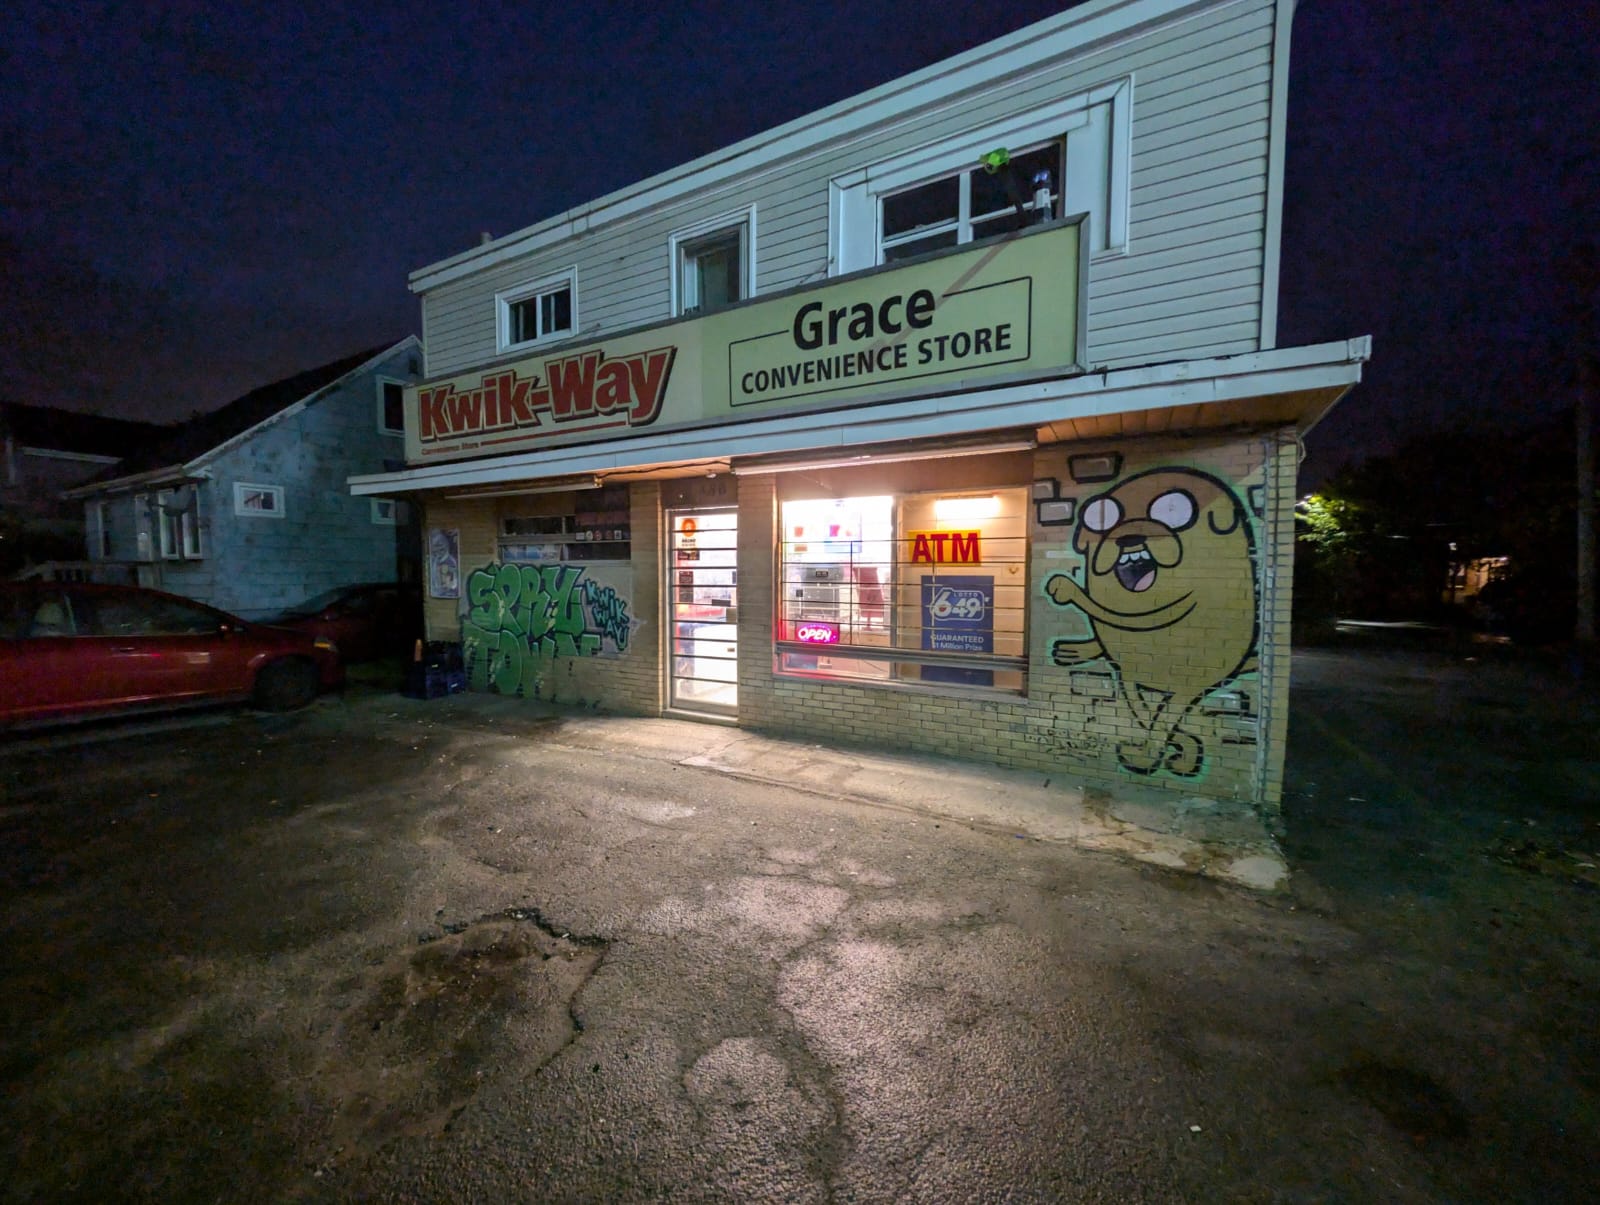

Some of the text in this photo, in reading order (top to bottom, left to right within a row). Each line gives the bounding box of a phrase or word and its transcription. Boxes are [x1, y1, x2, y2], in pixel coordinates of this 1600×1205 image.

[793, 289, 936, 351] Grace
[741, 323, 1012, 395] CONVENIENCE STORE
[418, 345, 678, 443] Kwik-Way
[911, 532, 981, 564] ATM
[798, 627, 832, 643] OPEN
[930, 634, 985, 643] GUARANTEED
